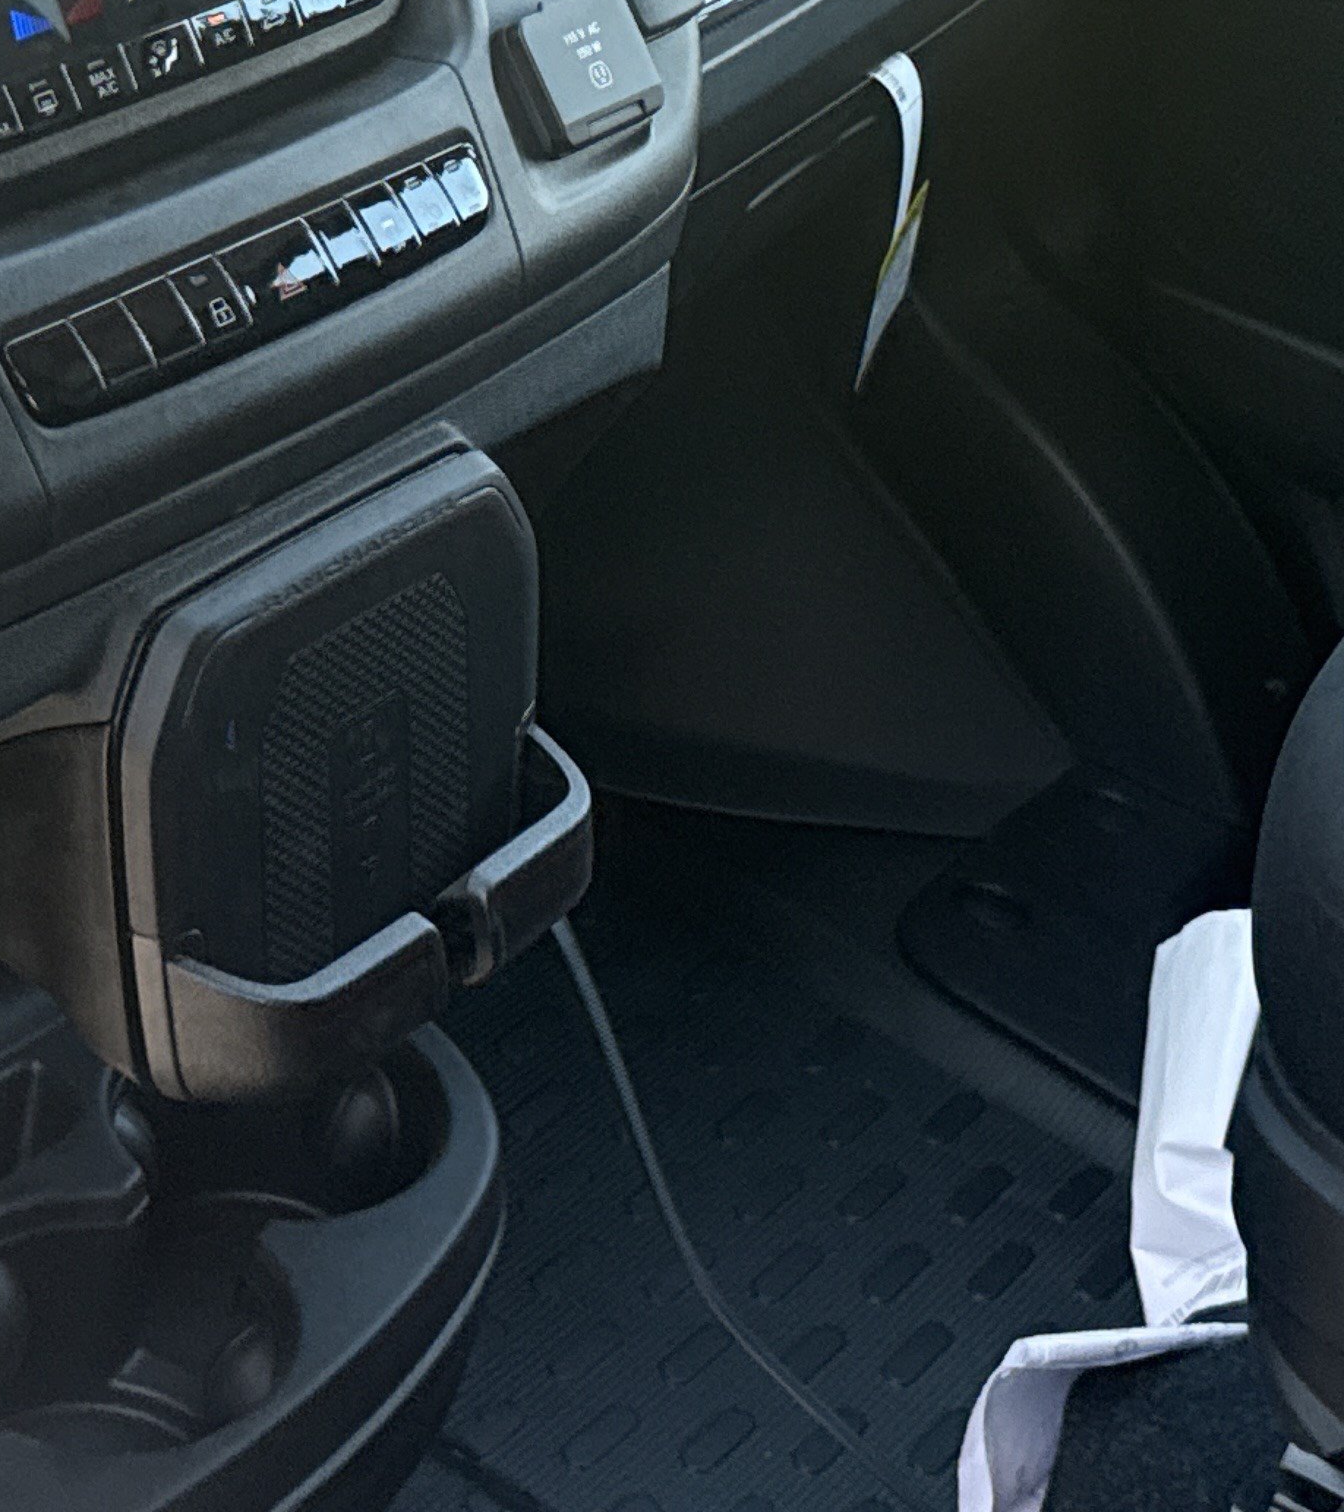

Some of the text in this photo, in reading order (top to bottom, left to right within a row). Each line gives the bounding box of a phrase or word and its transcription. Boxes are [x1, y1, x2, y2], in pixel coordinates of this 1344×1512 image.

[213, 26, 237, 47] AC
[88, 67, 117, 88] MAX
[98, 79, 120, 99] AC
